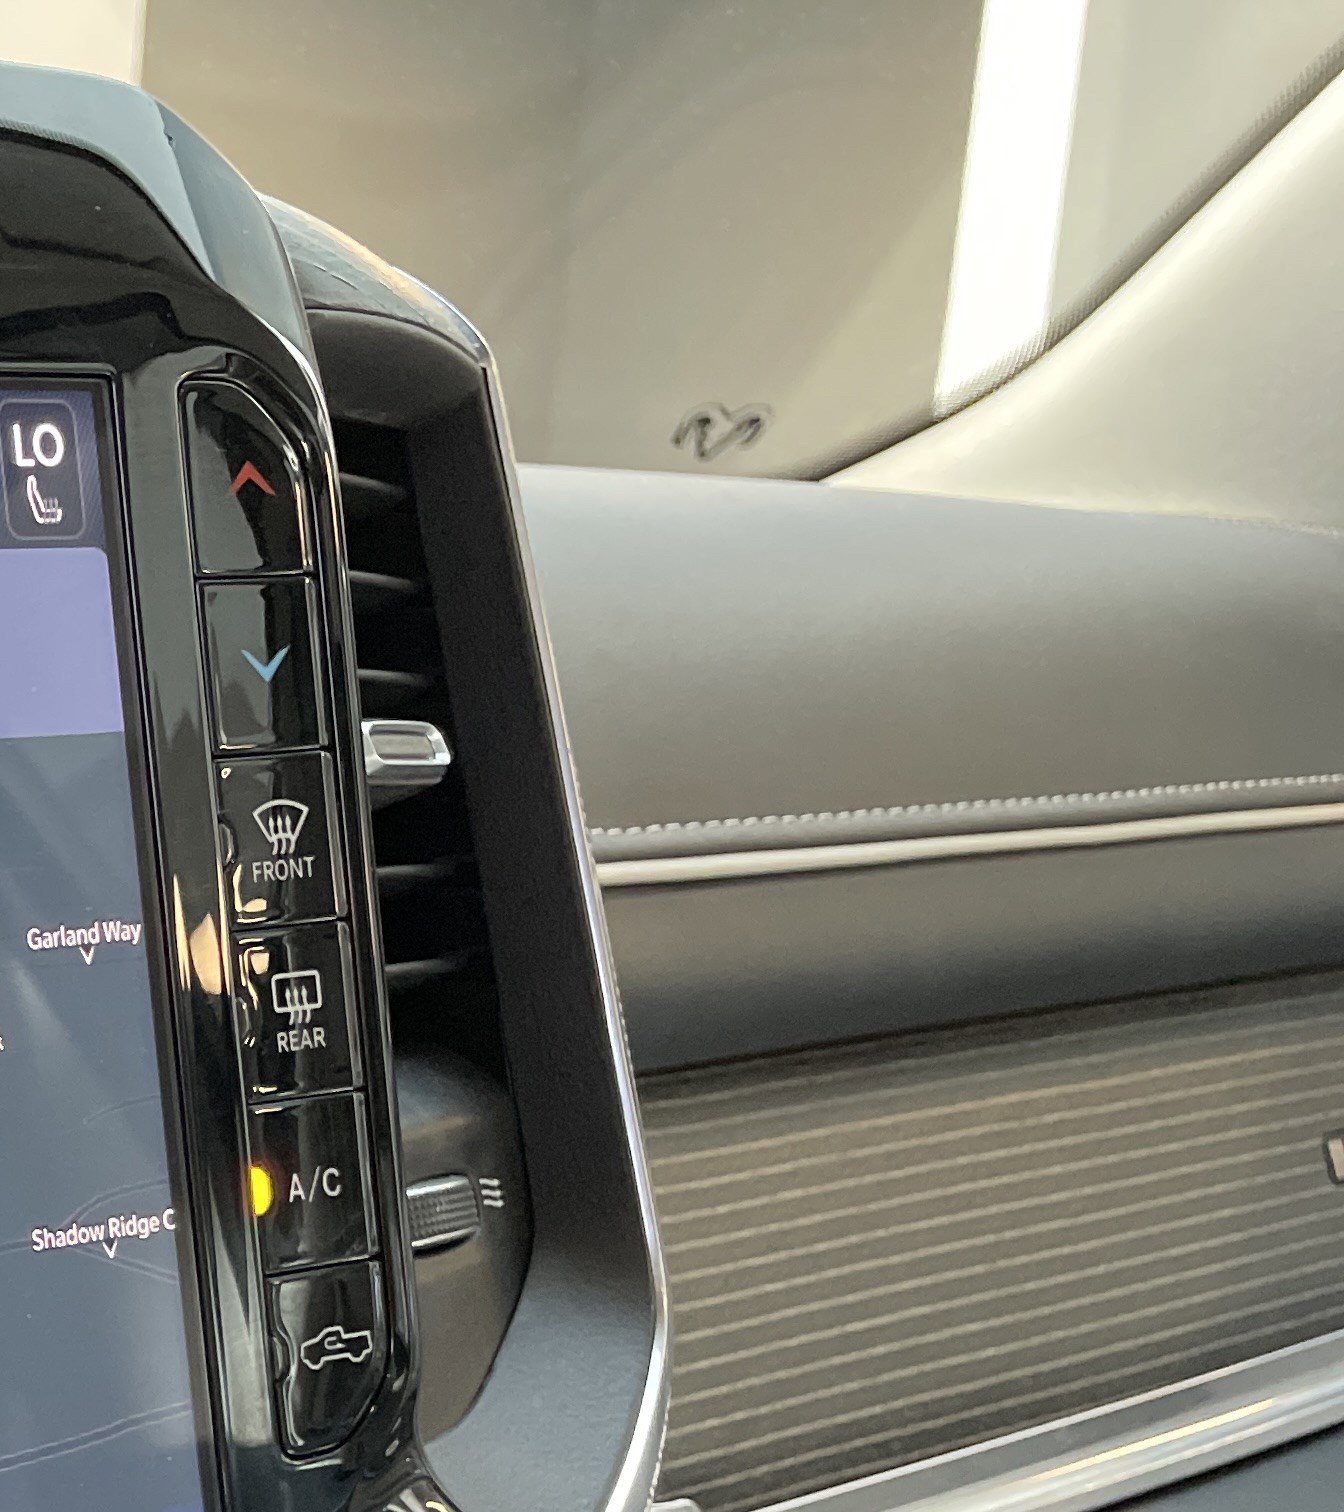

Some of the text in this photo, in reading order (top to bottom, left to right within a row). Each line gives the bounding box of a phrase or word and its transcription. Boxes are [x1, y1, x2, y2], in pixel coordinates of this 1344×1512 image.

[12, 423, 65, 467] LO
[252, 856, 315, 884] FRONT
[27, 920, 142, 951] Garland Way
[276, 1027, 326, 1053] REAR
[289, 1166, 341, 1202] A/C
[31, 1223, 105, 1251] Shadow
[108, 1215, 160, 1239] Ridge
